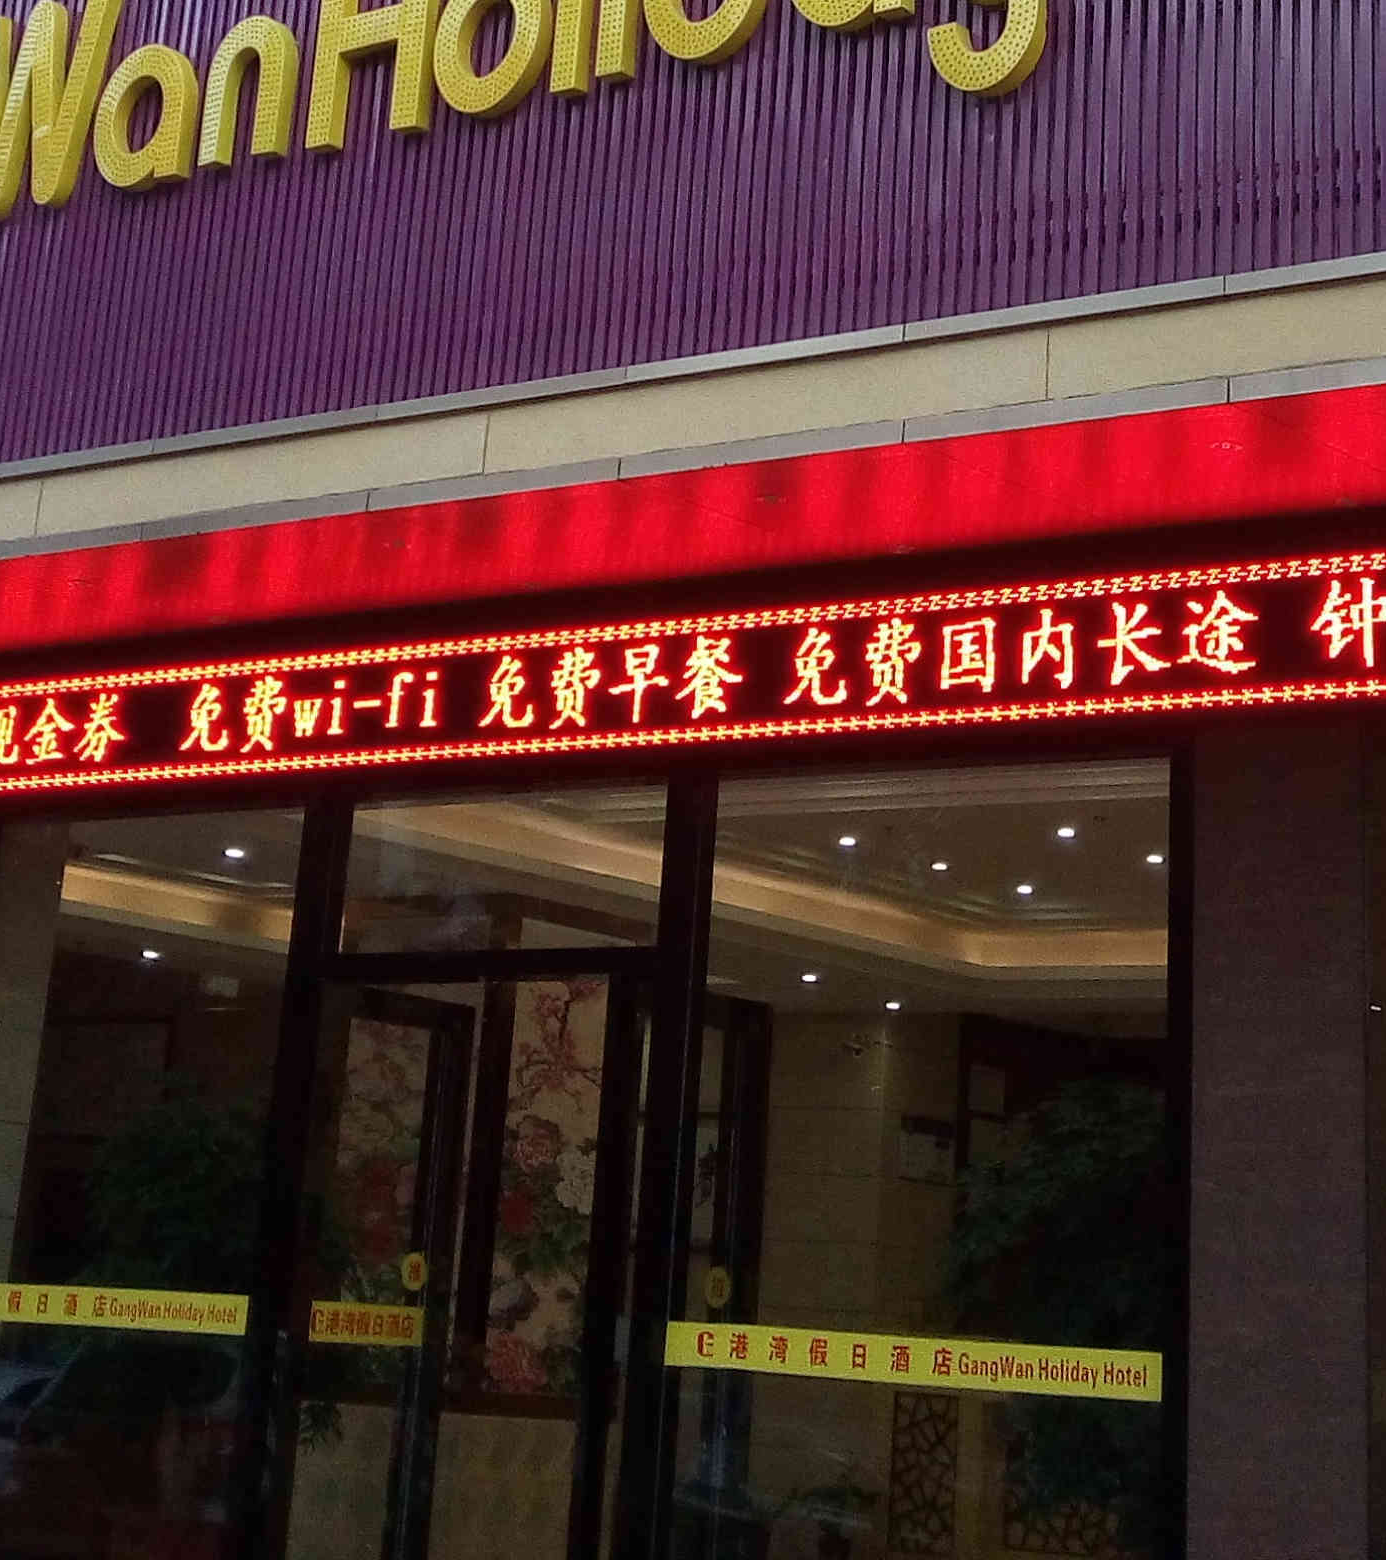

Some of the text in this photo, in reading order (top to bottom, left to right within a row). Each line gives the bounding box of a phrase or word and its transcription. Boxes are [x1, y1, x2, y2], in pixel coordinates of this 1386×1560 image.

[477, 634, 743, 730] 免费早餐
[782, 589, 1259, 708] 免费国内长途
[729, 1331, 953, 1378] 港湾假日酒店
[1037, 1358, 1100, 1388] Holiday
[1102, 1363, 1148, 1388] Hotel
